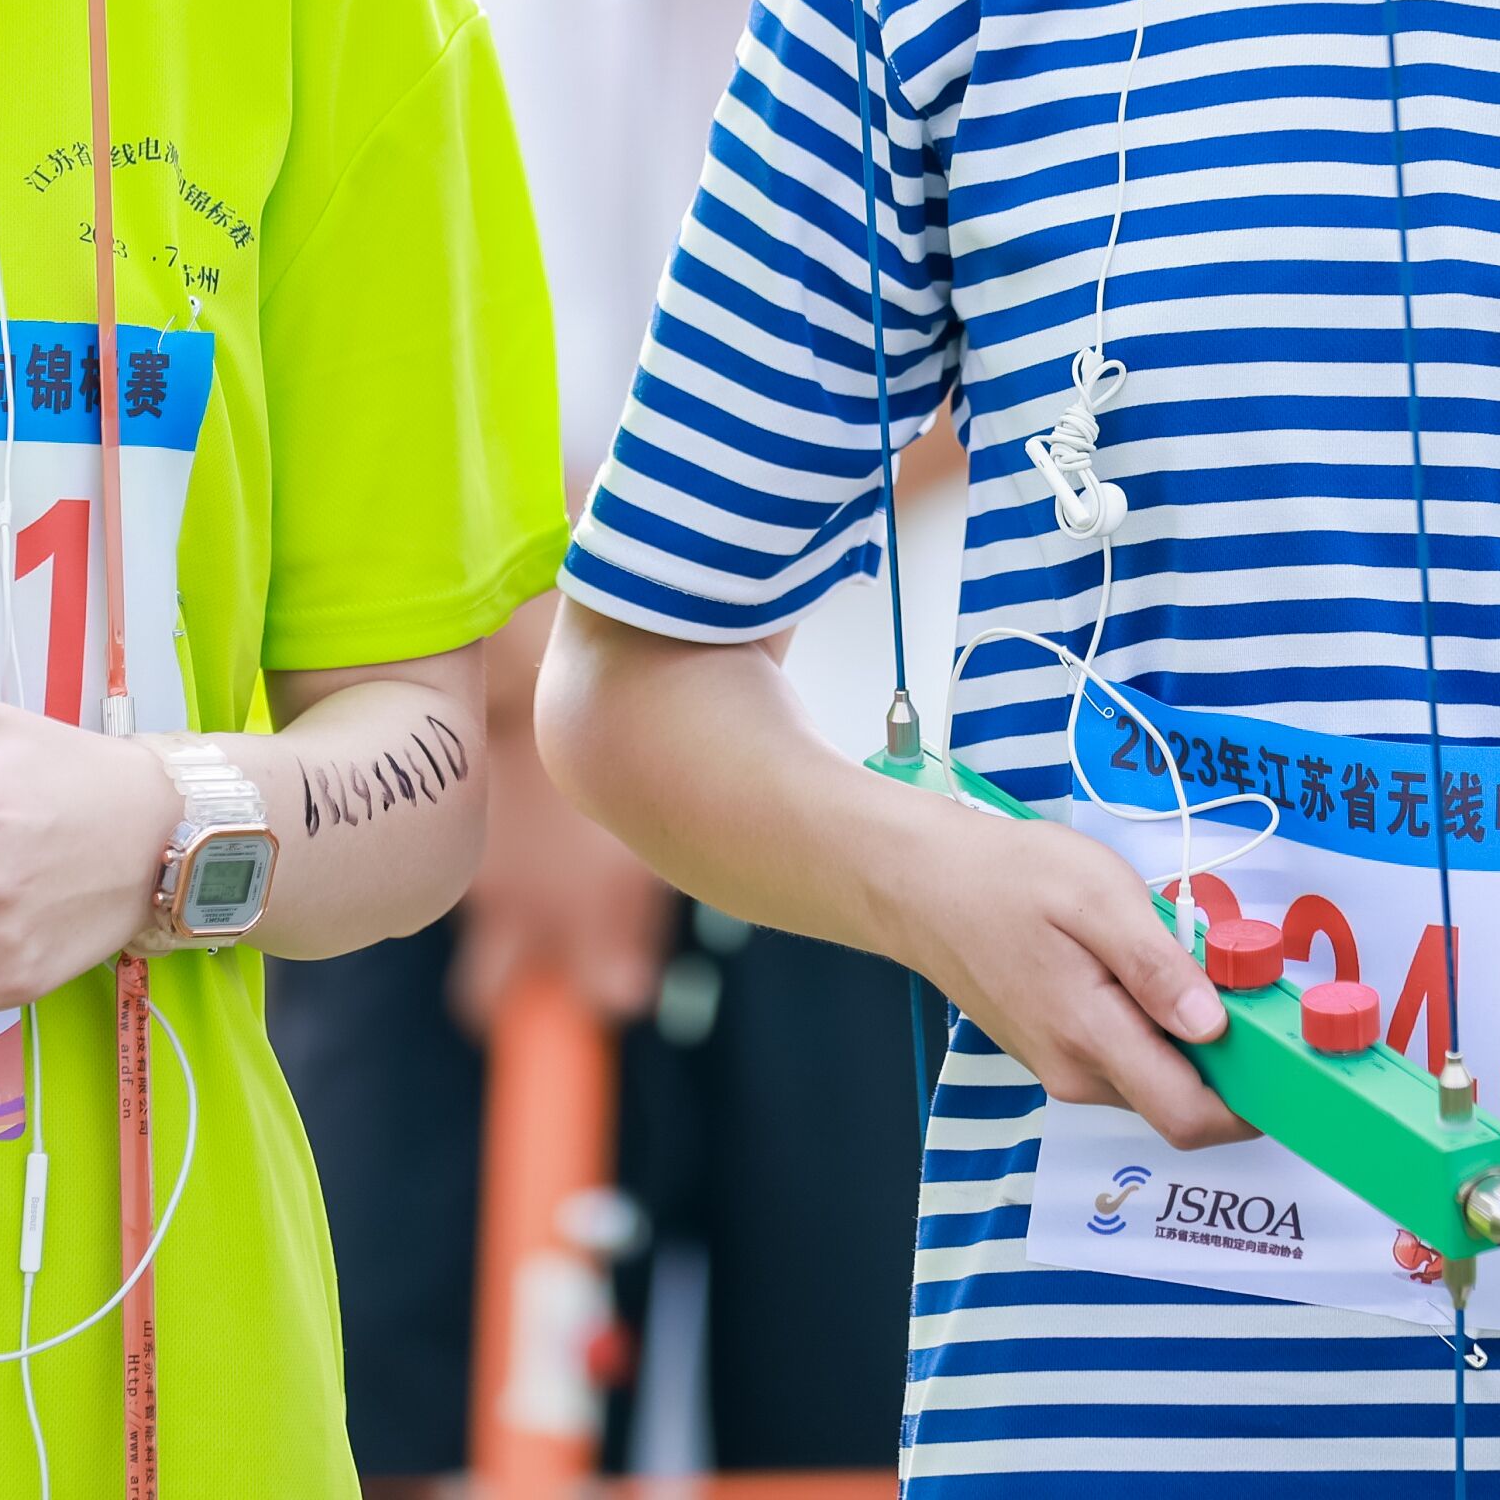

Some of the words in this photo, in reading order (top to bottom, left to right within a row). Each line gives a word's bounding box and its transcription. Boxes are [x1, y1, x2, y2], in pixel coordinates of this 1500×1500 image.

[1155, 1183, 1305, 1241] JSROA
[1154, 1225, 1304, 1260] 江苏省无线电和定向运动协会
